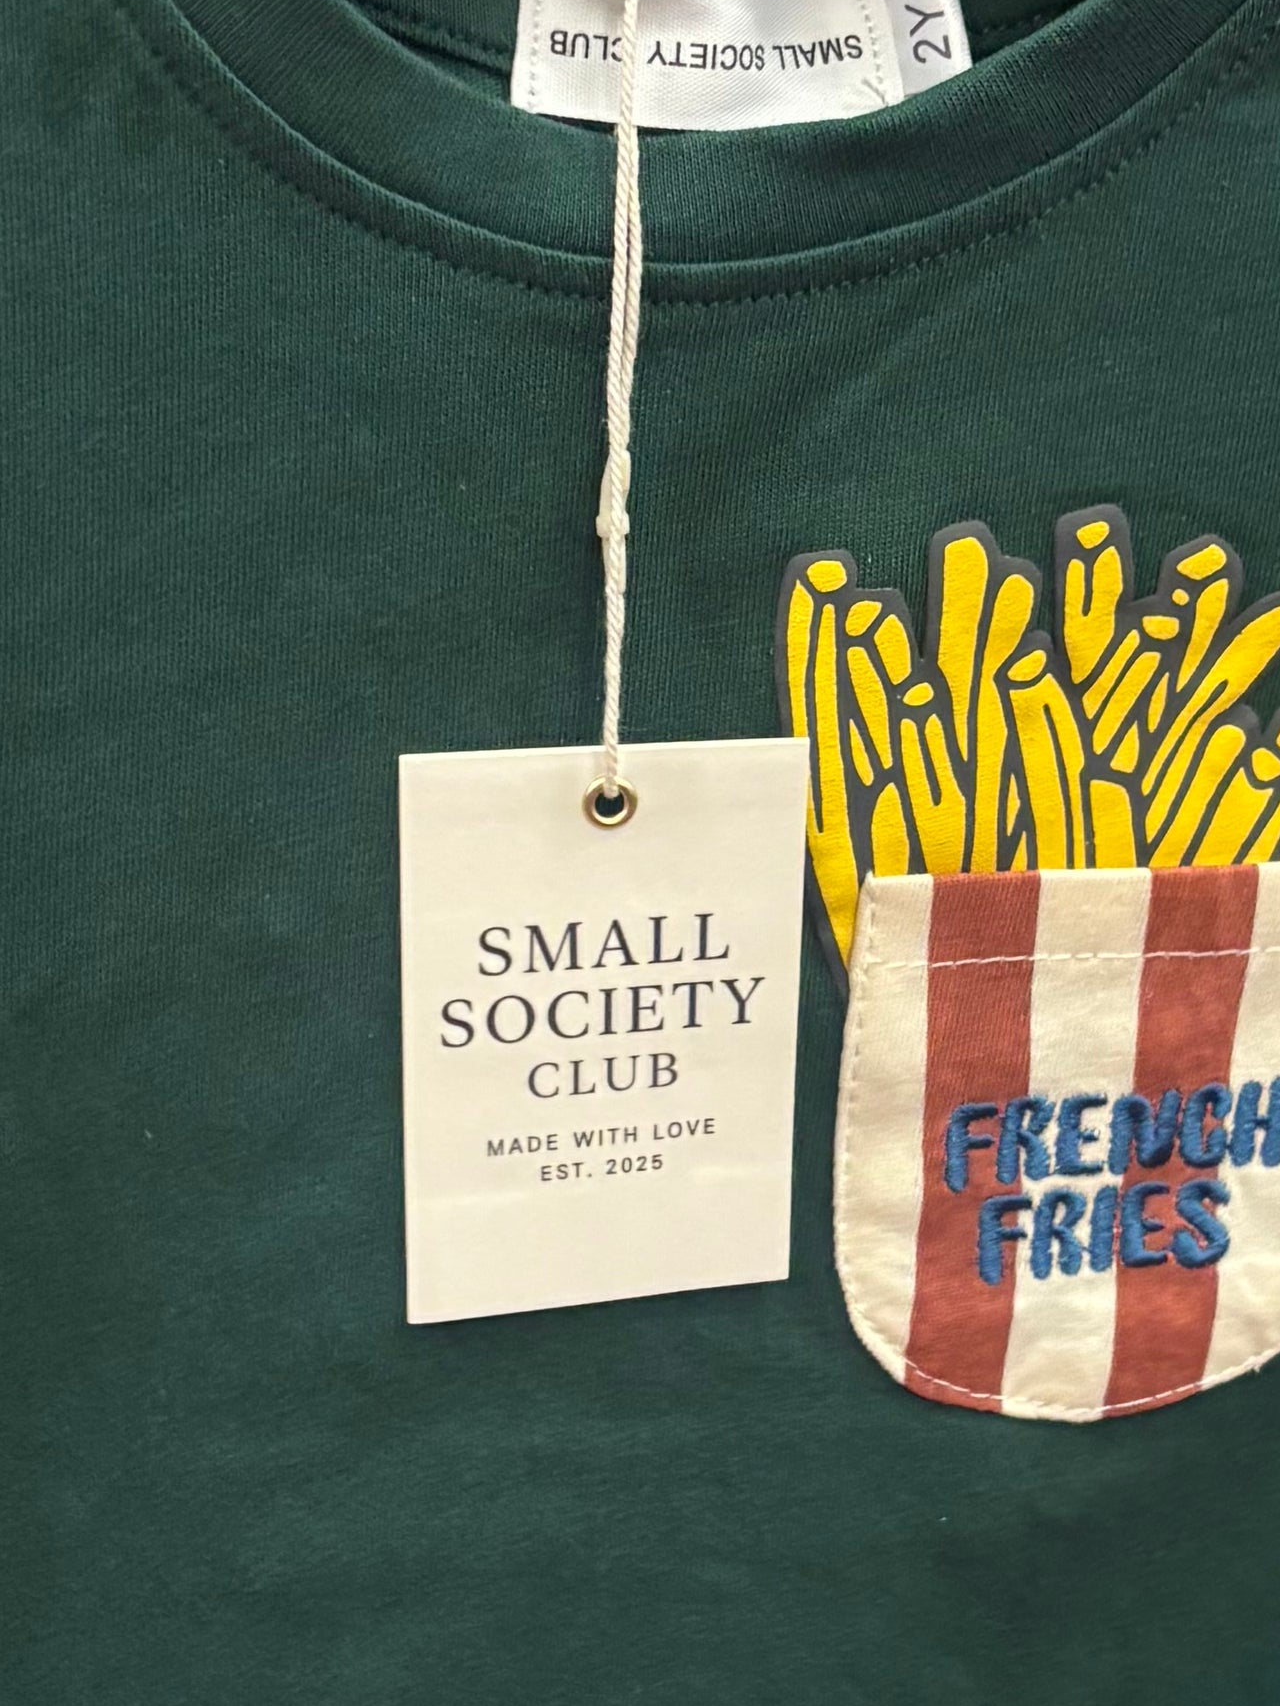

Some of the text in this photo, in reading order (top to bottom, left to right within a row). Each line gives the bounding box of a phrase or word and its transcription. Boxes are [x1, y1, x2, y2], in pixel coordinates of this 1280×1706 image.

[646, 40, 766, 71] SOCIETY
[772, 33, 865, 71] SMALL
[904, 2, 952, 64] 2Y
[477, 912, 731, 977] SMALL
[440, 976, 766, 1048] SOCIETY
[527, 1051, 679, 1099] CLUB
[486, 1117, 717, 1158] MADE WITH LOVE
[540, 1153, 664, 1182] EST. 2025
[976, 1178, 1232, 1286] FRIES
